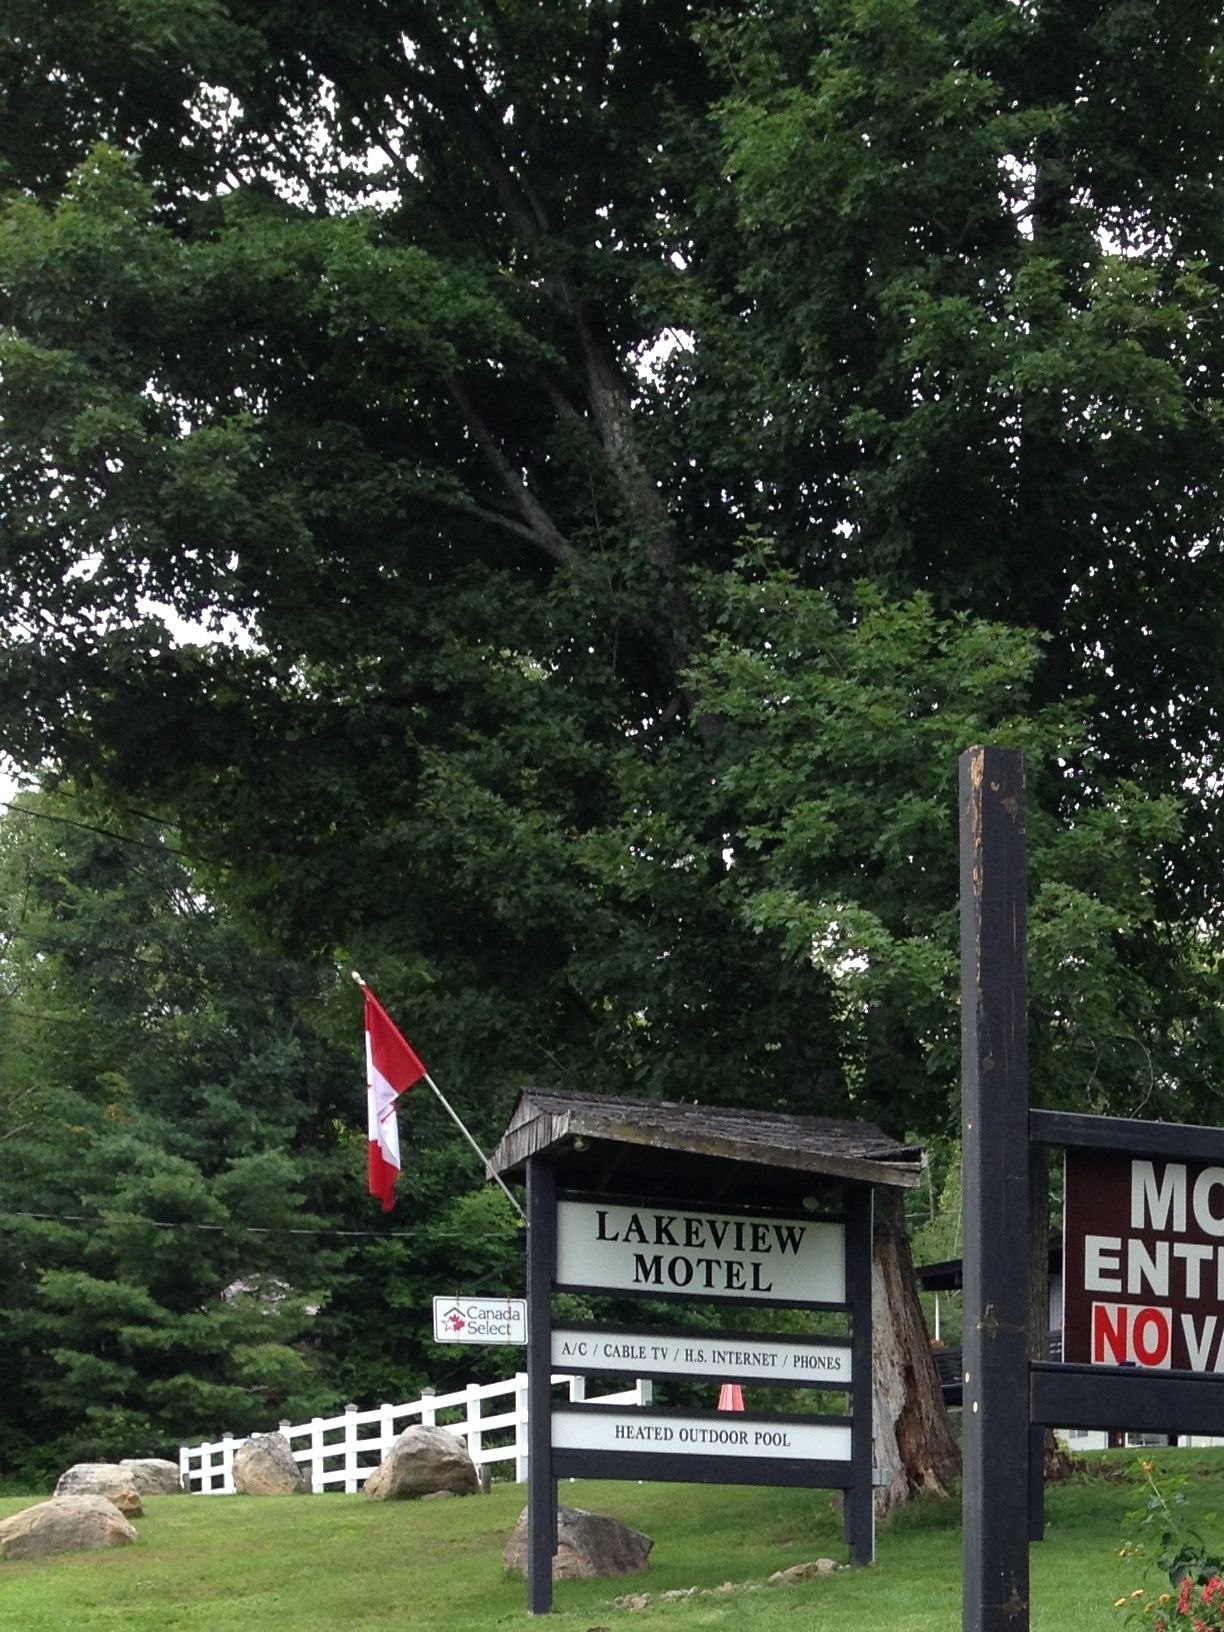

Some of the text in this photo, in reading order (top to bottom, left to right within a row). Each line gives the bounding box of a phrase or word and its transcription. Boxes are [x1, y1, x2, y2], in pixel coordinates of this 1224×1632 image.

[596, 1210, 806, 1255] LAKEVIEW
[633, 1253, 773, 1293] MOTEL
[467, 1305, 521, 1321] Canada
[467, 1320, 512, 1335] Select
[1094, 1305, 1170, 1367] NO
[561, 1342, 588, 1356] A/C
[603, 1344, 646, 1359] CABLE
[651, 1346, 669, 1361] TV
[684, 1348, 708, 1363] H.S.
[712, 1349, 778, 1367] INTERNET
[793, 1355, 841, 1370] PHONES
[615, 1424, 791, 1447] HEATED OUTDOOR POOL
